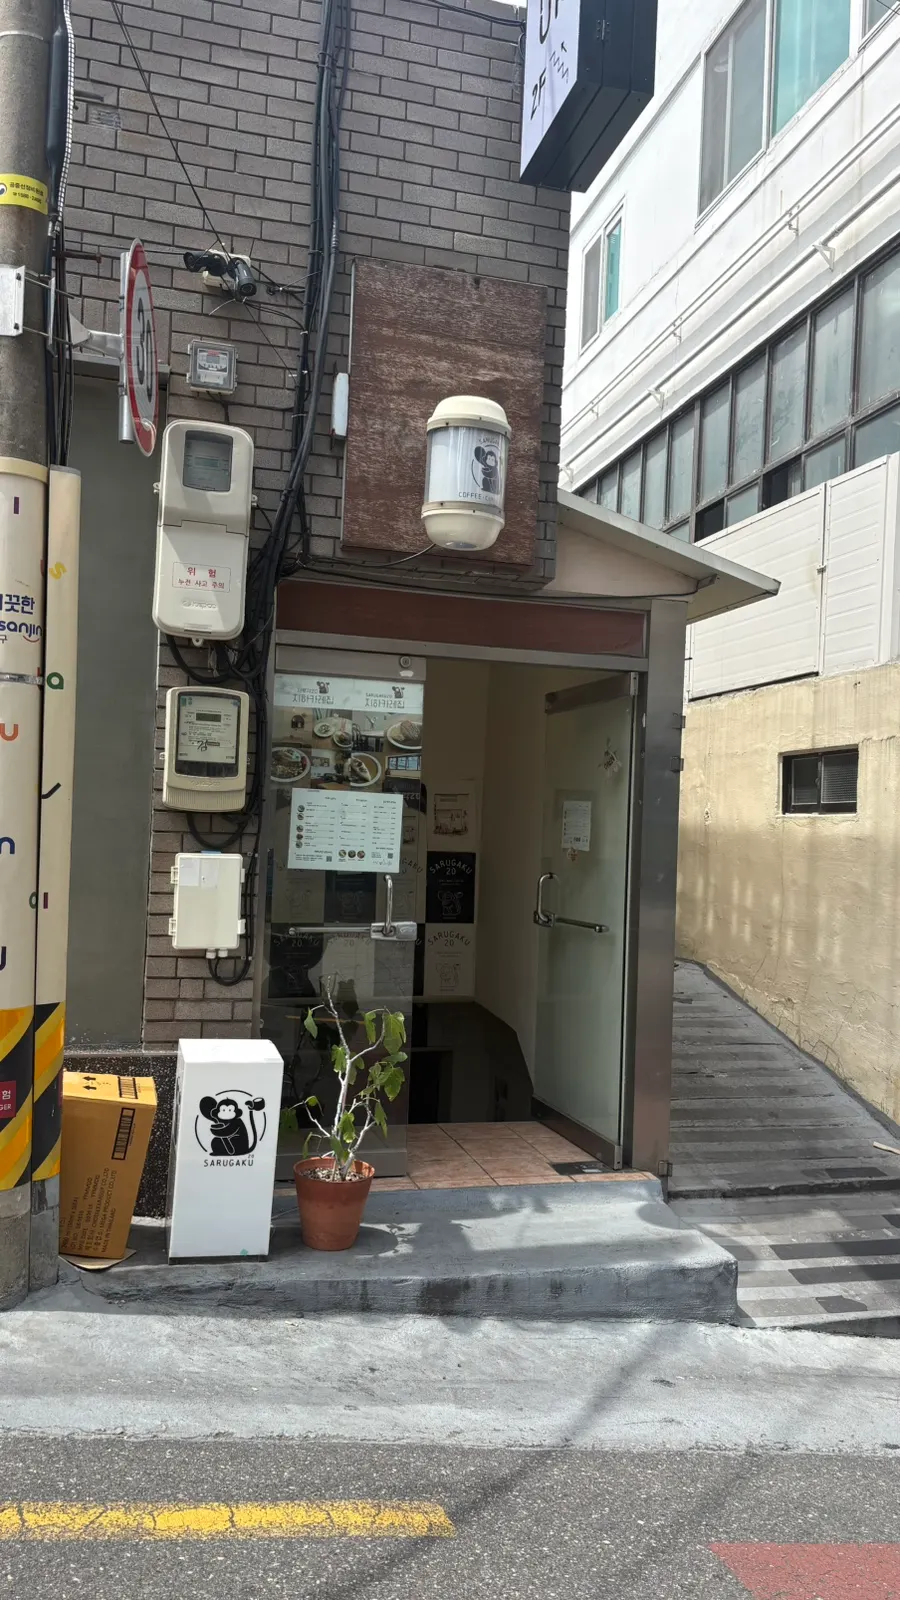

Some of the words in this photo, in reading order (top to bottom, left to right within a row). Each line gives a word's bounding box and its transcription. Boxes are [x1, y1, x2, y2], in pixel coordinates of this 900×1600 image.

[530, 68, 547, 121] 2F
[136, 296, 153, 404] 30
[458, 491, 482, 500] COFFEE
[0, 593, 35, 615] 끗한
[429, 859, 472, 875] SARUGAKU
[446, 867, 456, 875] 20
[428, 931, 471, 947] SARUGAKU
[444, 939, 455, 947] 20
[2, 1090, 11, 1100] 험
[203, 1159, 254, 1167] SARUGAKU
